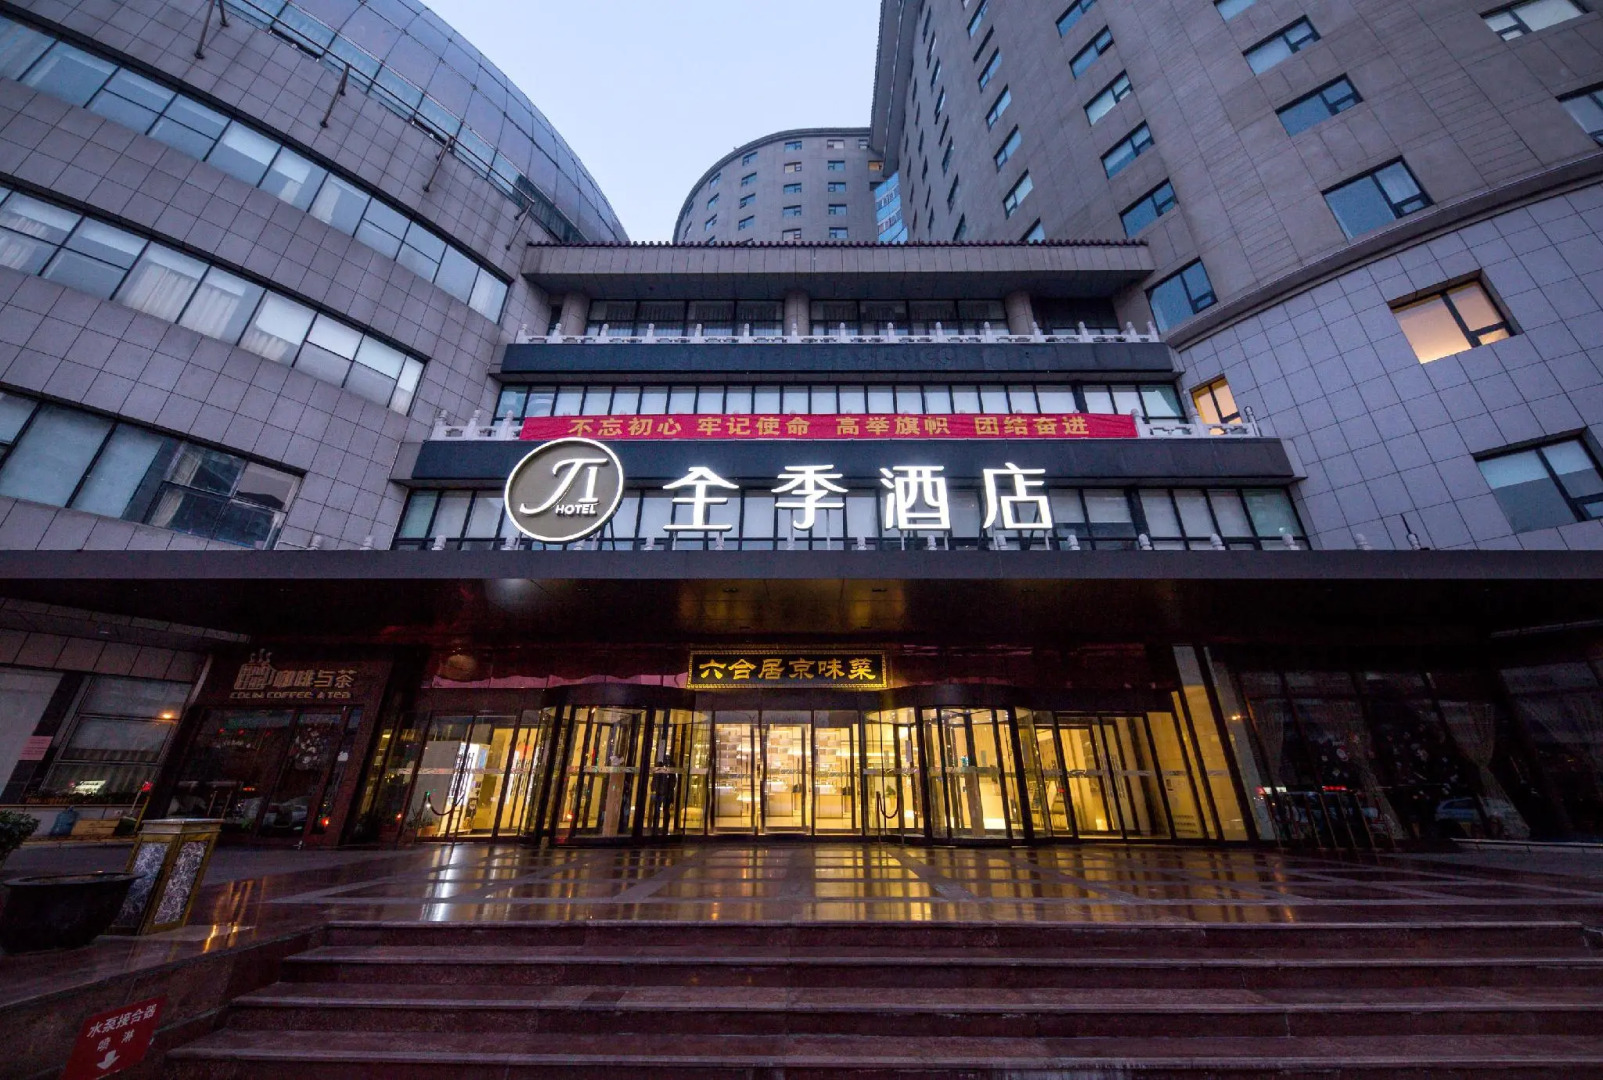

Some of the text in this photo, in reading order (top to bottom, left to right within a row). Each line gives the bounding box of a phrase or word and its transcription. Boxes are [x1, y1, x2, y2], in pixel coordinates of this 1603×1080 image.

[568, 416, 1090, 436] 不忘初心 牢记使命 高举旗帜 团结奋进
[662, 462, 1053, 531] 全季酒店
[555, 504, 597, 515] HOTEL
[699, 657, 877, 680] 六合居京味菜
[86, 1004, 157, 1038] 水泵接合器
